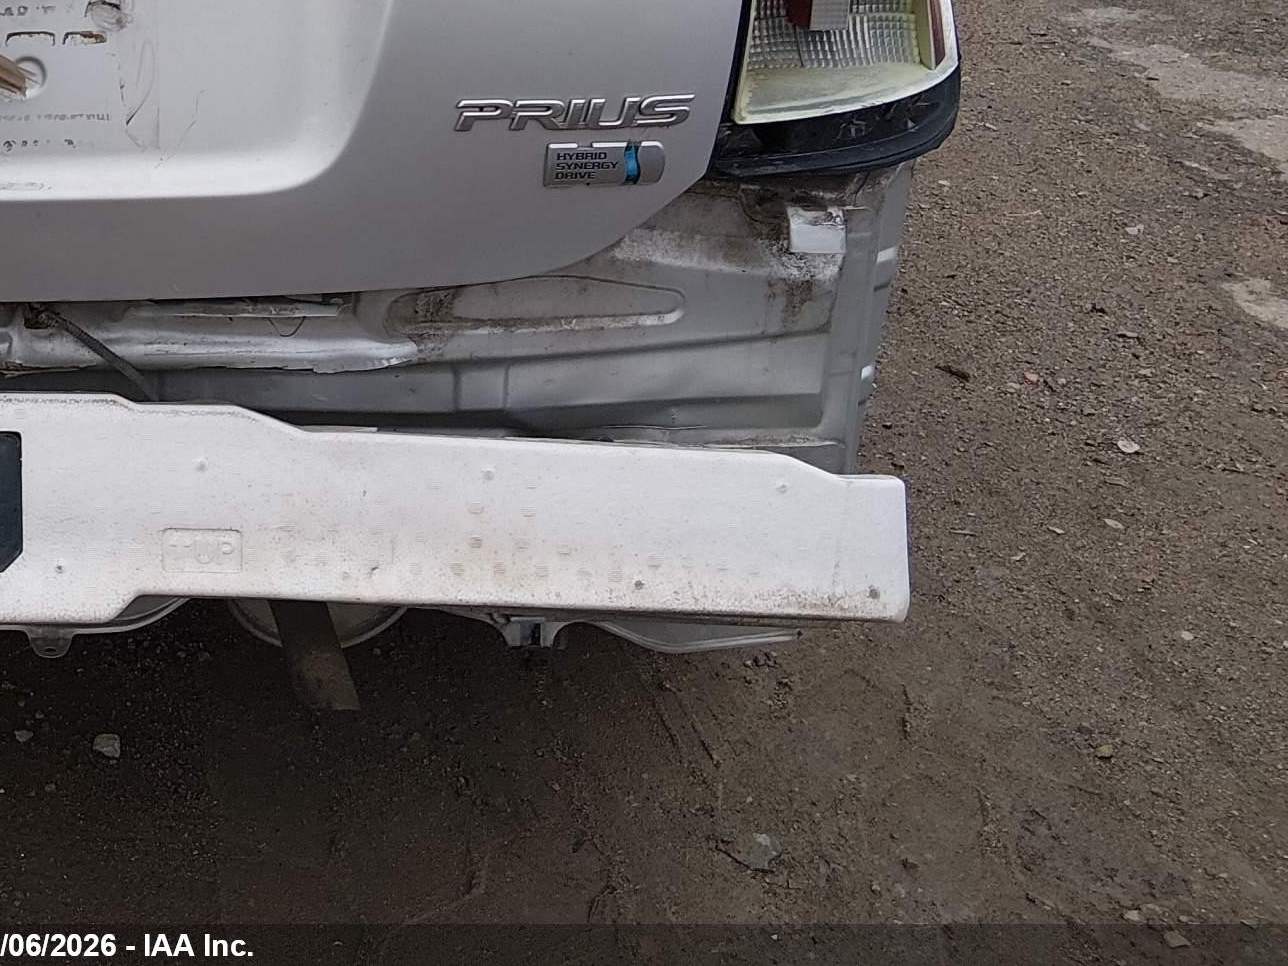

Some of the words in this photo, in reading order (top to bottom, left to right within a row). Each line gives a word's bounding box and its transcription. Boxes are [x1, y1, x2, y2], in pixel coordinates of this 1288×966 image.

[454, 94, 696, 133] PRIUS
[556, 152, 608, 161] HYBRID
[555, 161, 619, 171] SYNERGY
[555, 170, 596, 180] DRIVE
